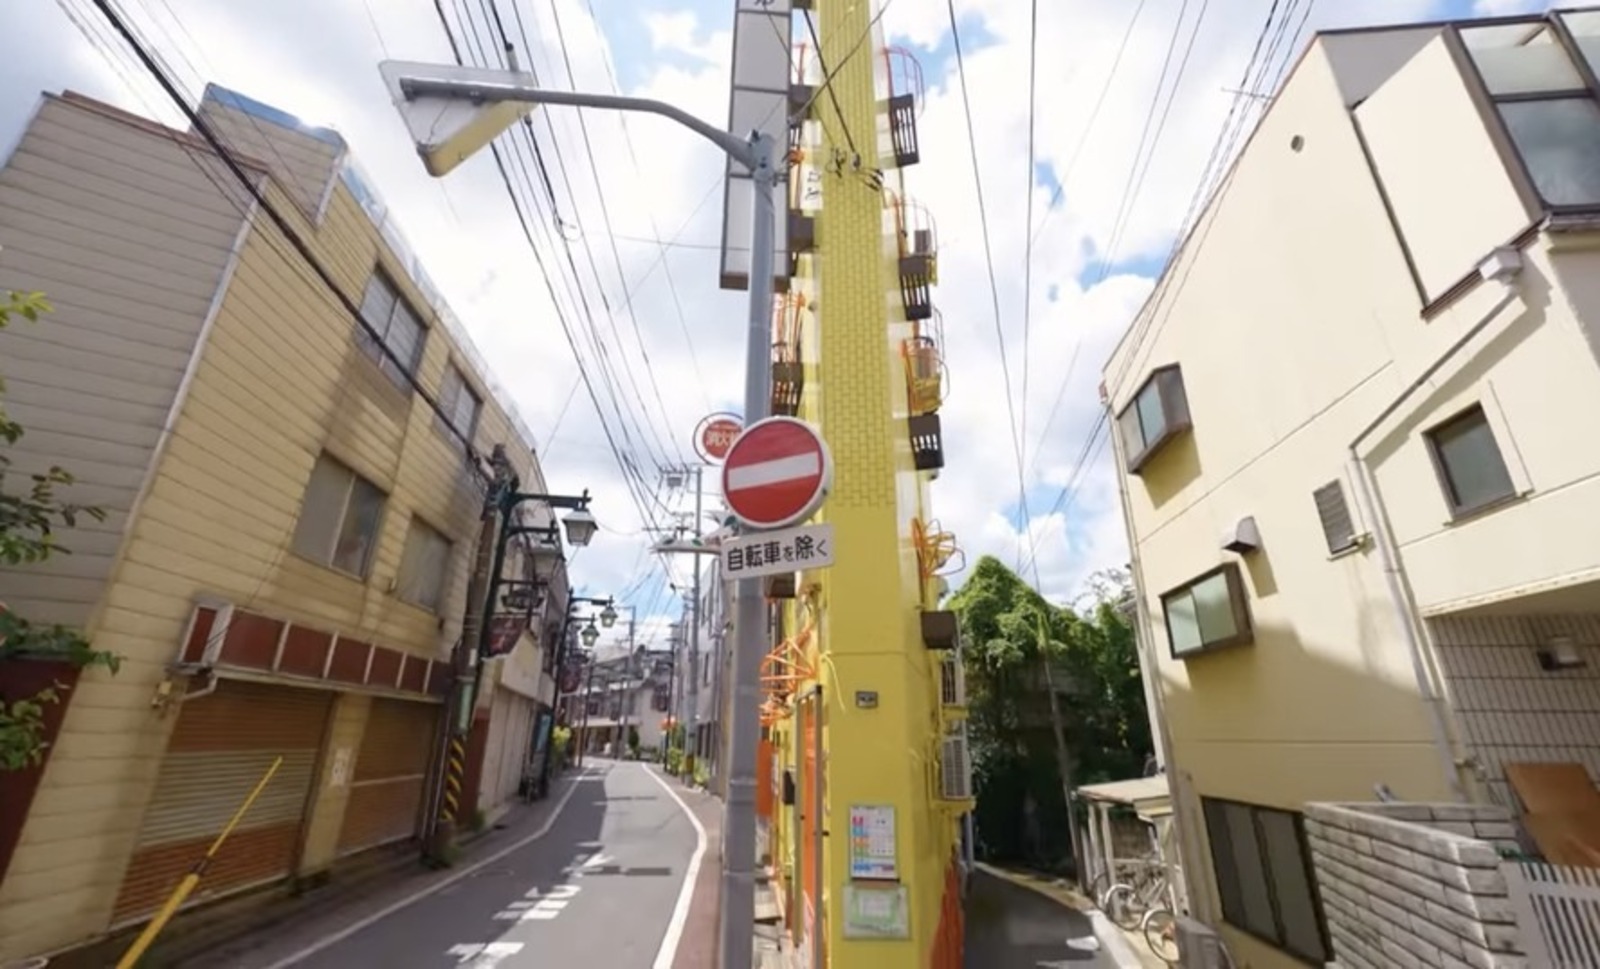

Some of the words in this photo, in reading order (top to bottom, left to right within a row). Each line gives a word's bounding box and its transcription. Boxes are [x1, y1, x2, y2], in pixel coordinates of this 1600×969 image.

[727, 535, 828, 571] 自転車を除く
